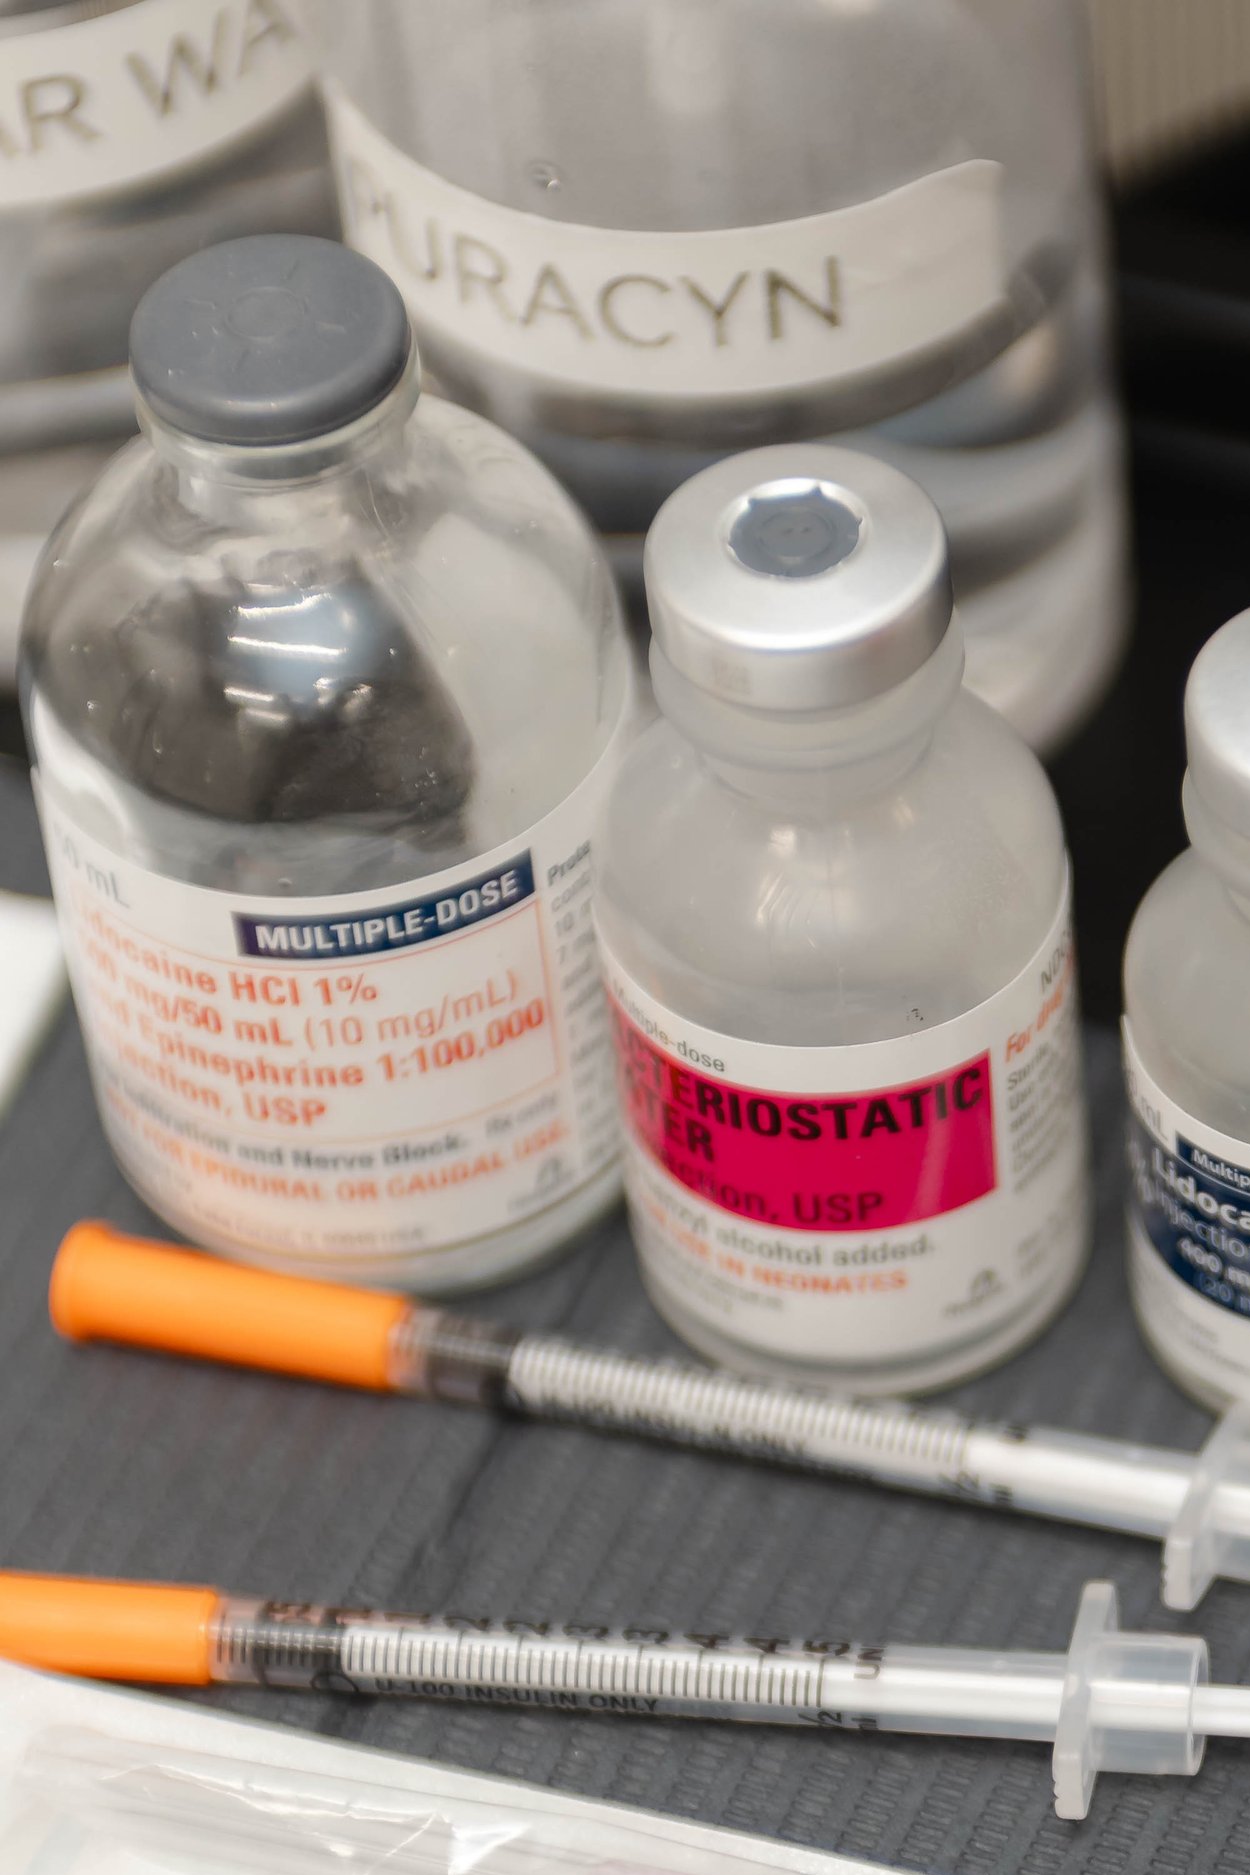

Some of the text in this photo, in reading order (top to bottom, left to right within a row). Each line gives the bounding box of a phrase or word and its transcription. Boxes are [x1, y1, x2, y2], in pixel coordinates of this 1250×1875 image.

[346, 158, 843, 350] PURACYN
[254, 868, 519, 952] MULTIPLE-DOSE
[228, 968, 301, 1007] HCl
[313, 973, 379, 1006] 1%
[233, 1015, 294, 1047] mL
[303, 1014, 365, 1051] (10
[376, 967, 518, 1041] mg/mL)
[137, 1011, 365, 1090] Epinephrine
[375, 996, 546, 1081] 1:100,000
[241, 1091, 327, 1128] USP
[791, 1190, 885, 1225] USP
[715, 1224, 823, 1267] alcohol
[464, 1683, 578, 1707] INSULIN
[588, 1691, 659, 1714] ONLY
